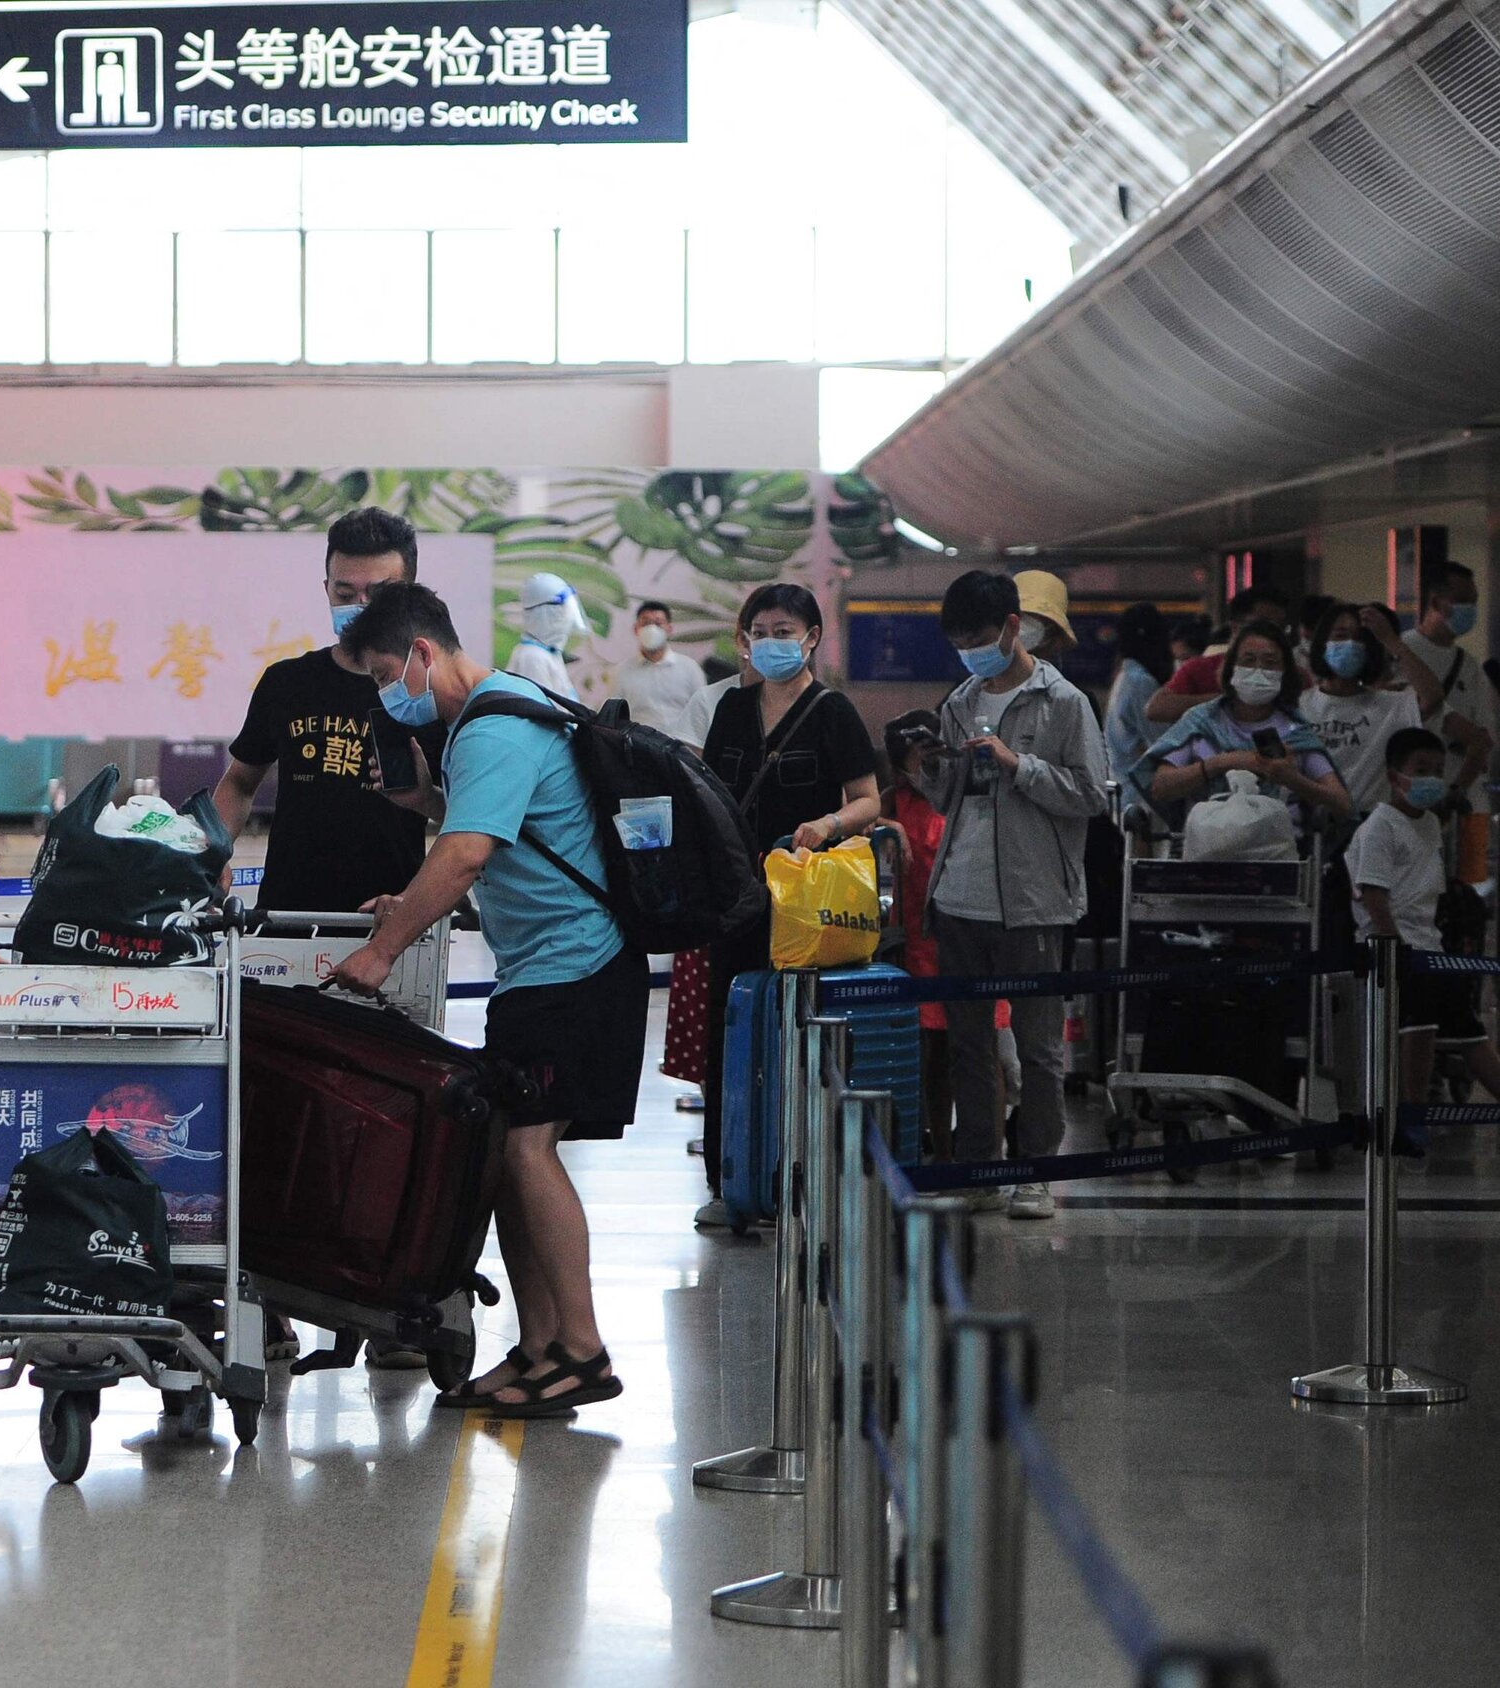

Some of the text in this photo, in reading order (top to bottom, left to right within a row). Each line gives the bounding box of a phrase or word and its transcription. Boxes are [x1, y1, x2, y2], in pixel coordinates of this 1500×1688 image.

[174, 24, 612, 90] 头等舱安检通道
[174, 98, 639, 132] First Class Lounge Security Check
[43, 1297, 69, 1310] Please
[70, 1305, 85, 1315] use
